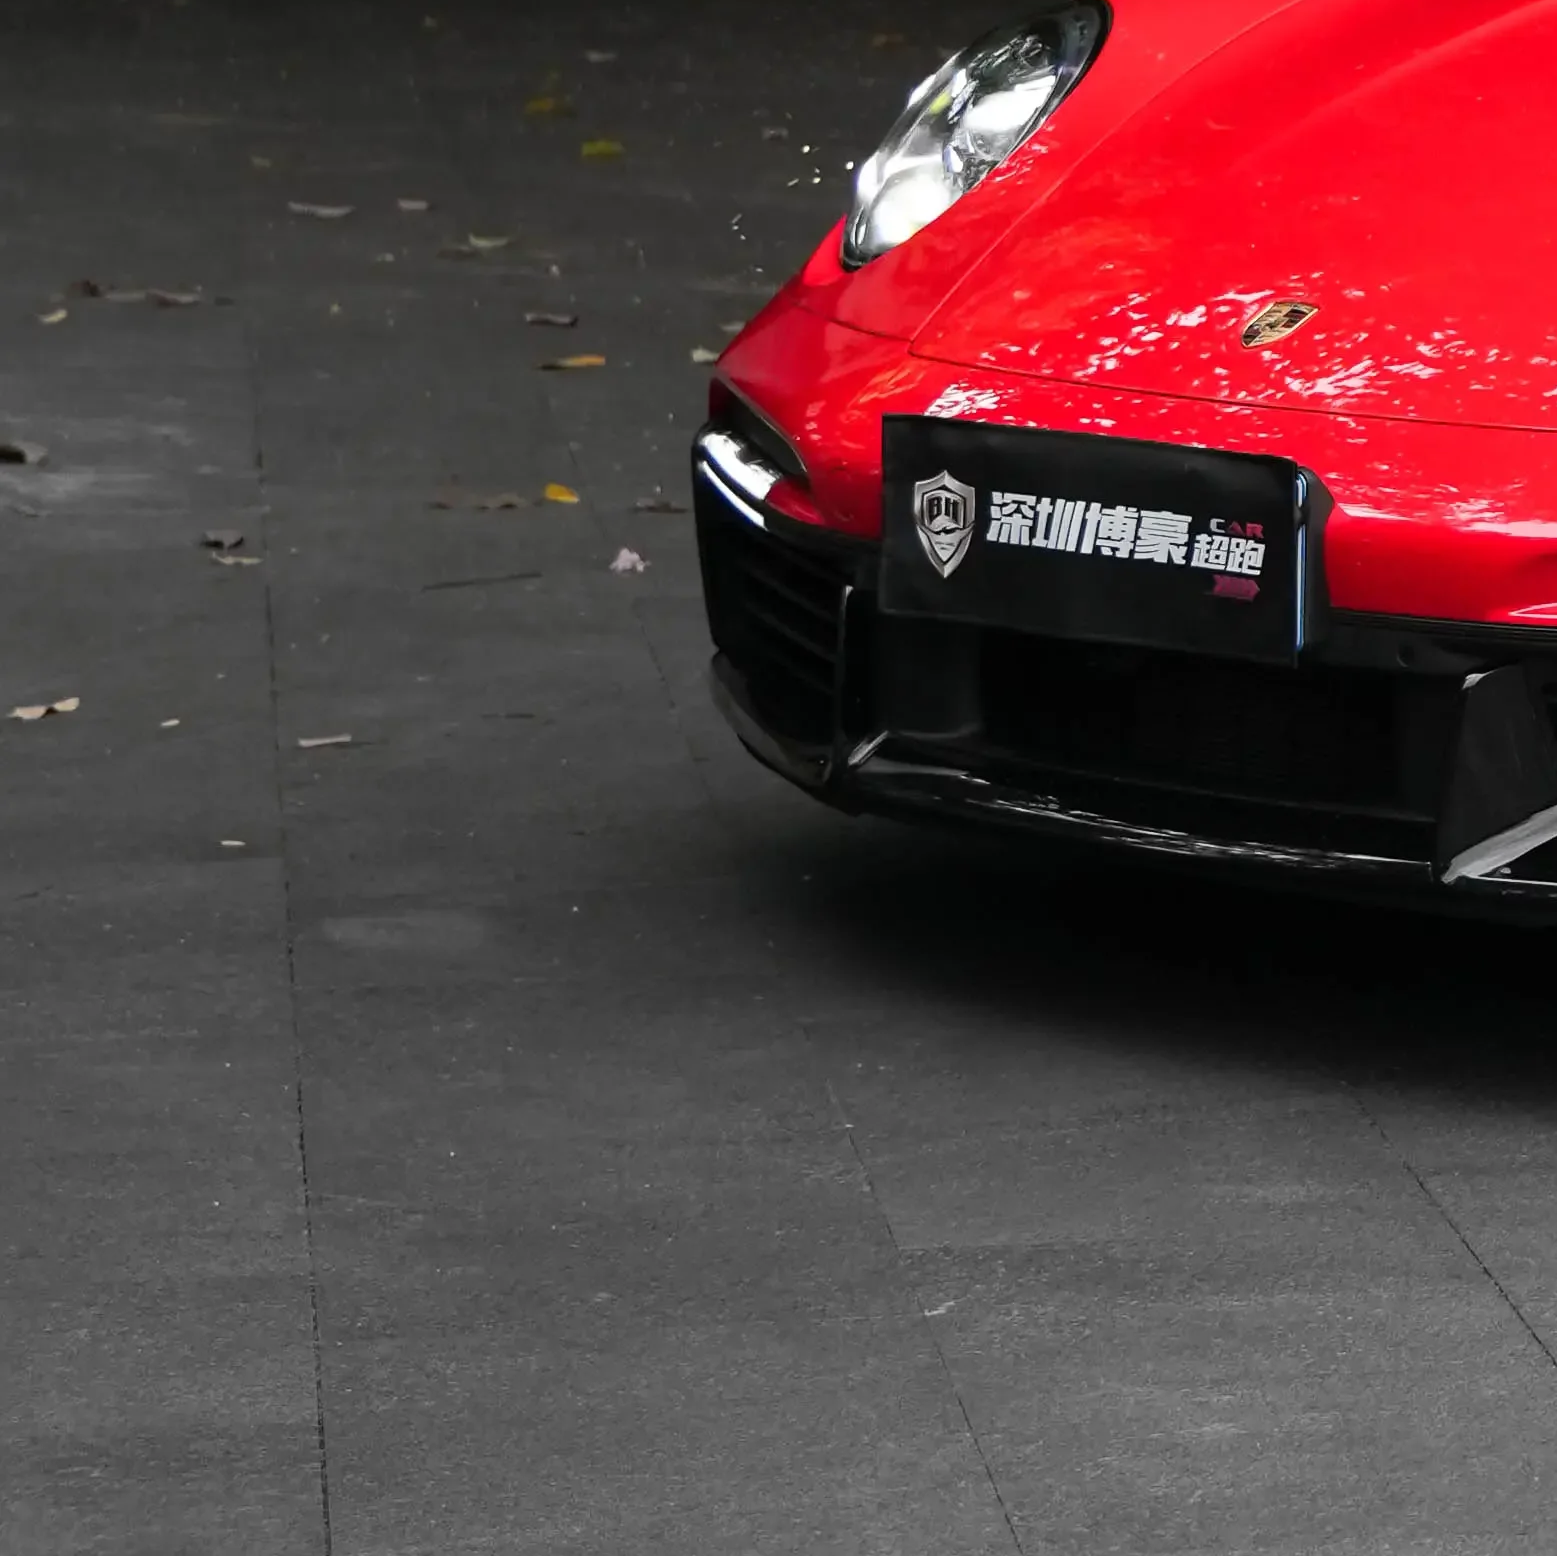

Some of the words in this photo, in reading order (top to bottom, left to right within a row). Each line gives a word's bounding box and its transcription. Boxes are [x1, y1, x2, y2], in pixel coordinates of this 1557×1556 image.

[928, 496, 960, 526] BH
[986, 491, 1193, 565] 深圳博豪
[1191, 533, 1265, 576] 超跑
[1210, 518, 1264, 539] CAR
